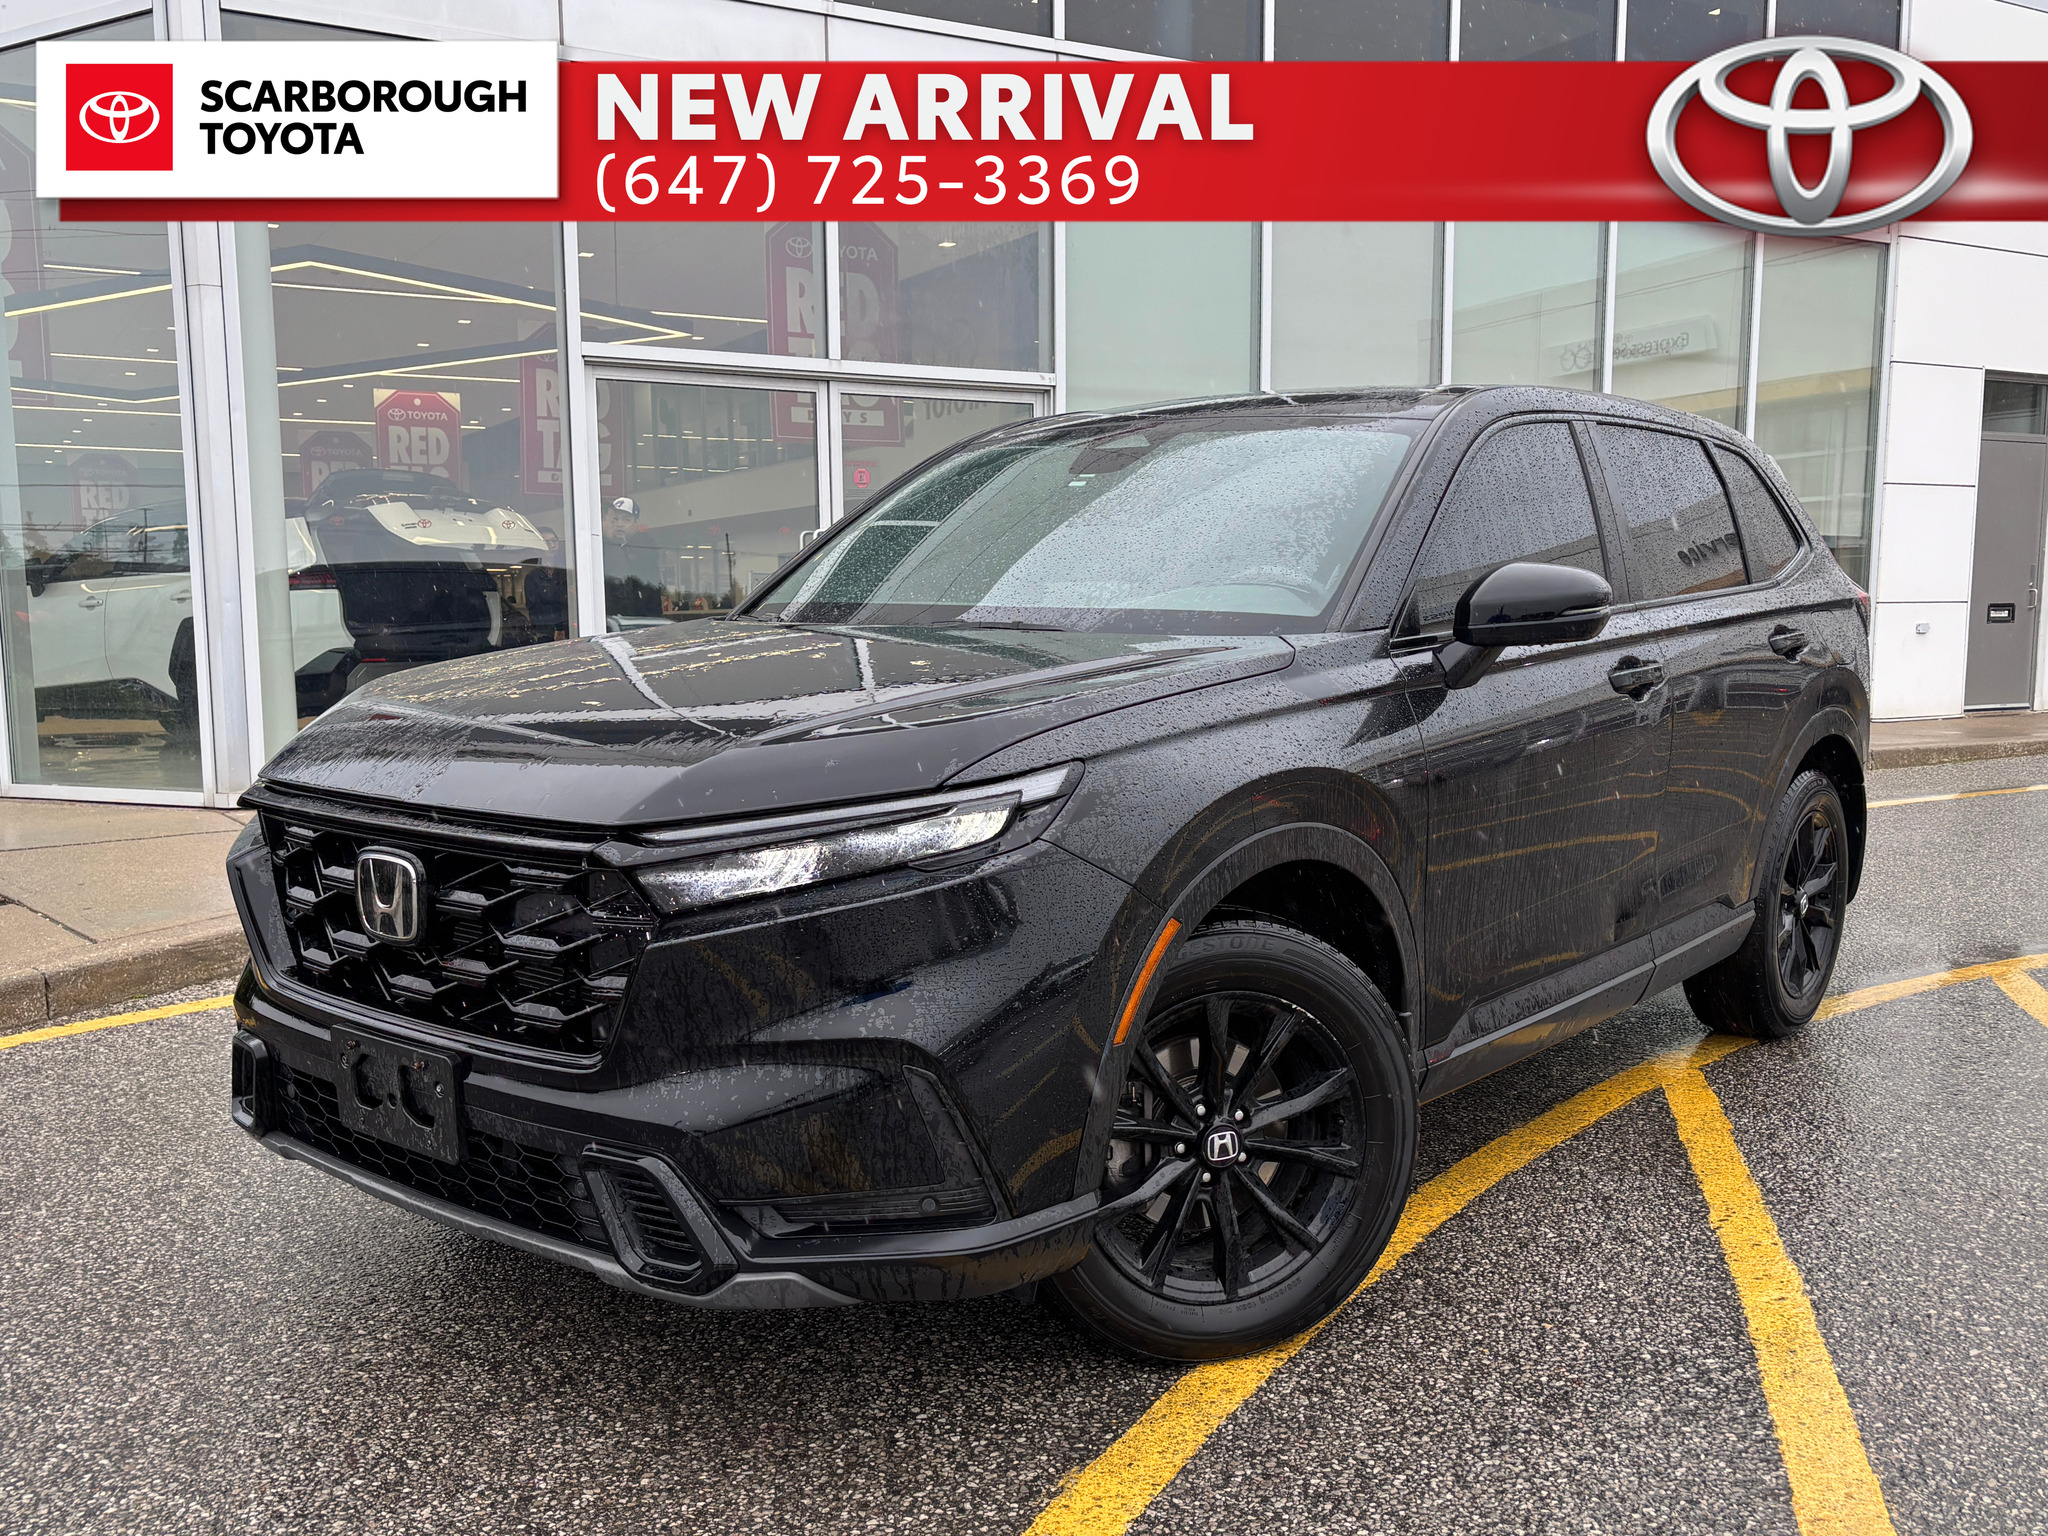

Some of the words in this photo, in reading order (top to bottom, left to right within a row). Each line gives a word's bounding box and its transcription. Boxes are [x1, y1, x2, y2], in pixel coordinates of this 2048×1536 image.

[407, 410, 448, 421] TOYOTA
[327, 447, 363, 456] TOYOTA
[388, 425, 450, 466] RED
[79, 480, 129, 509] RED
